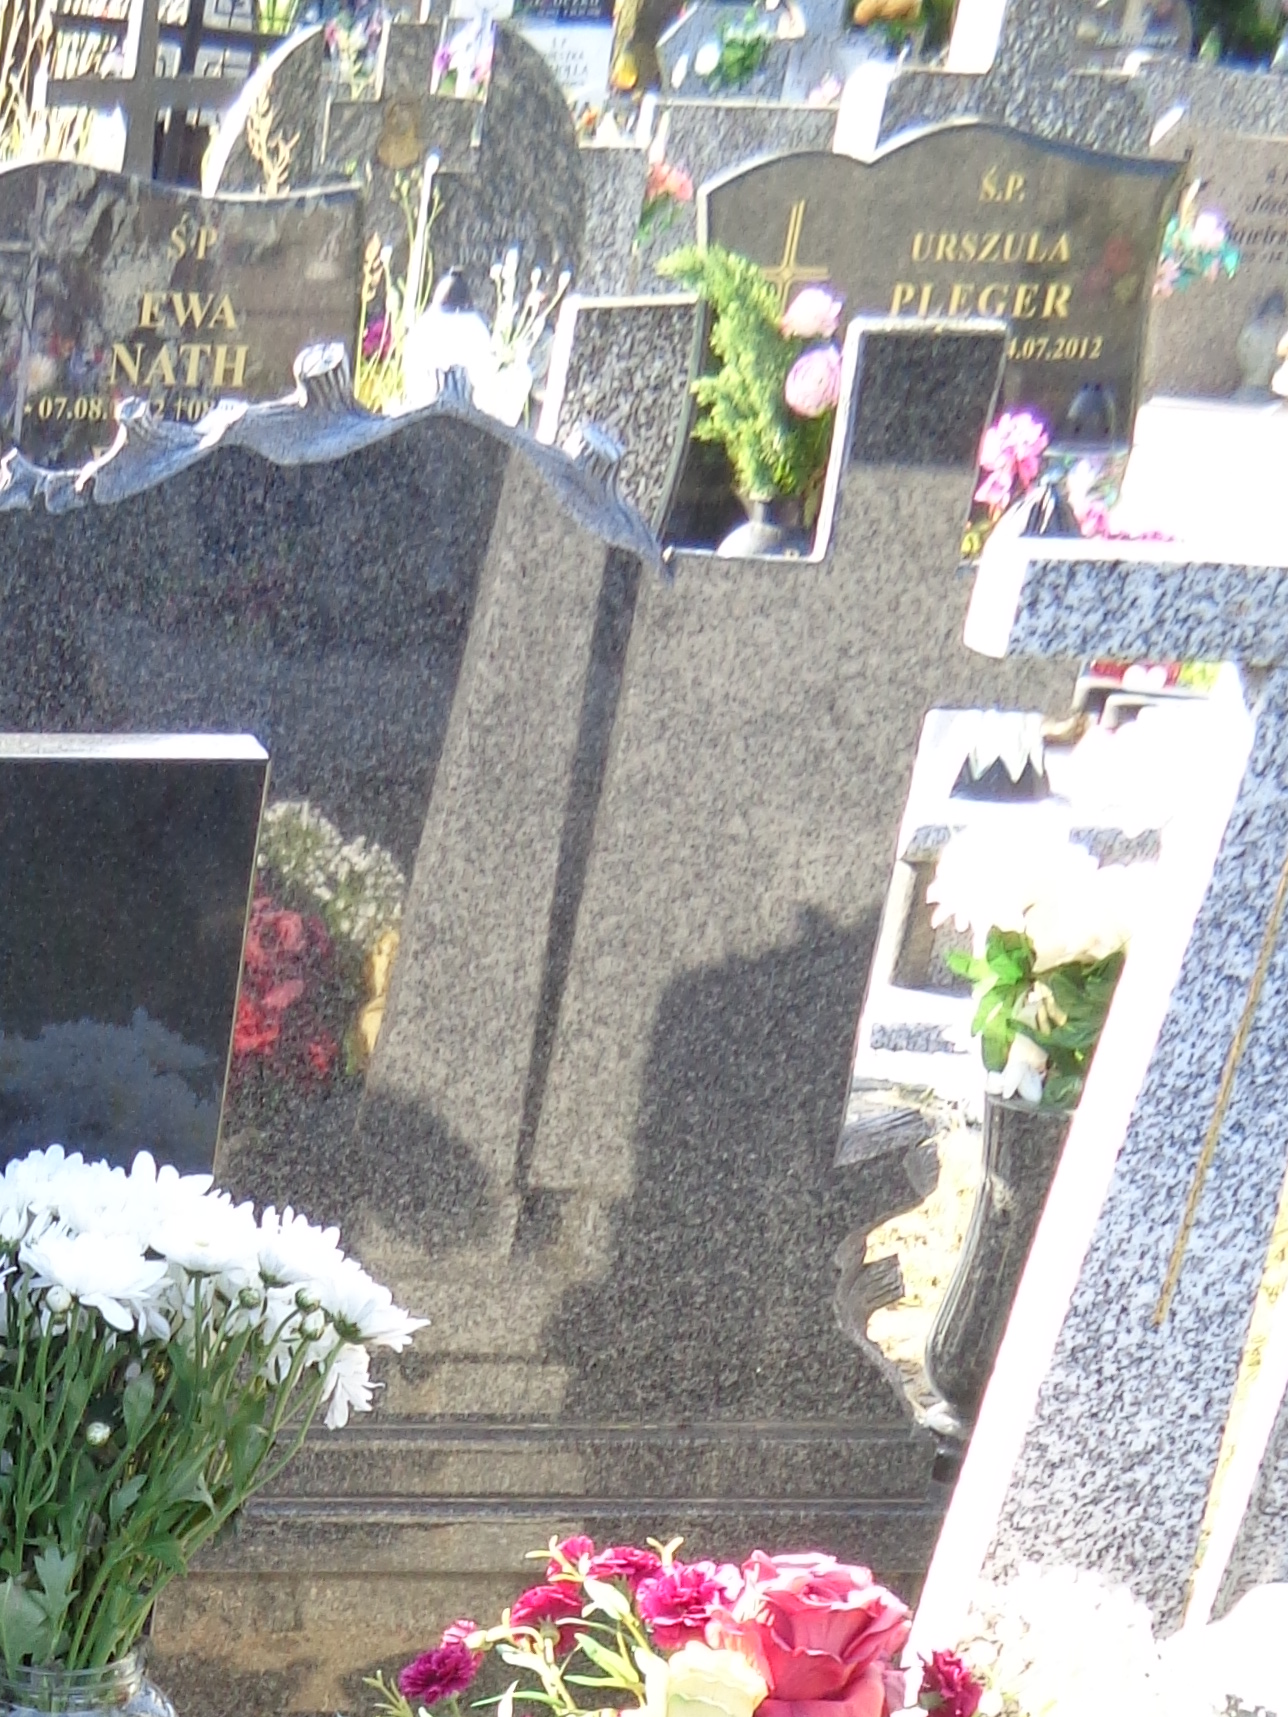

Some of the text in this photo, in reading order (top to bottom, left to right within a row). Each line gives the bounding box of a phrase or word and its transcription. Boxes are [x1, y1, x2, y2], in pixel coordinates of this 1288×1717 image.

[911, 230, 1072, 264] URSZULA
[139, 291, 237, 329] EWA
[889, 282, 1072, 321] PLEGER
[109, 343, 250, 388] NATH
[38, 396, 165, 421] 07.08.2
